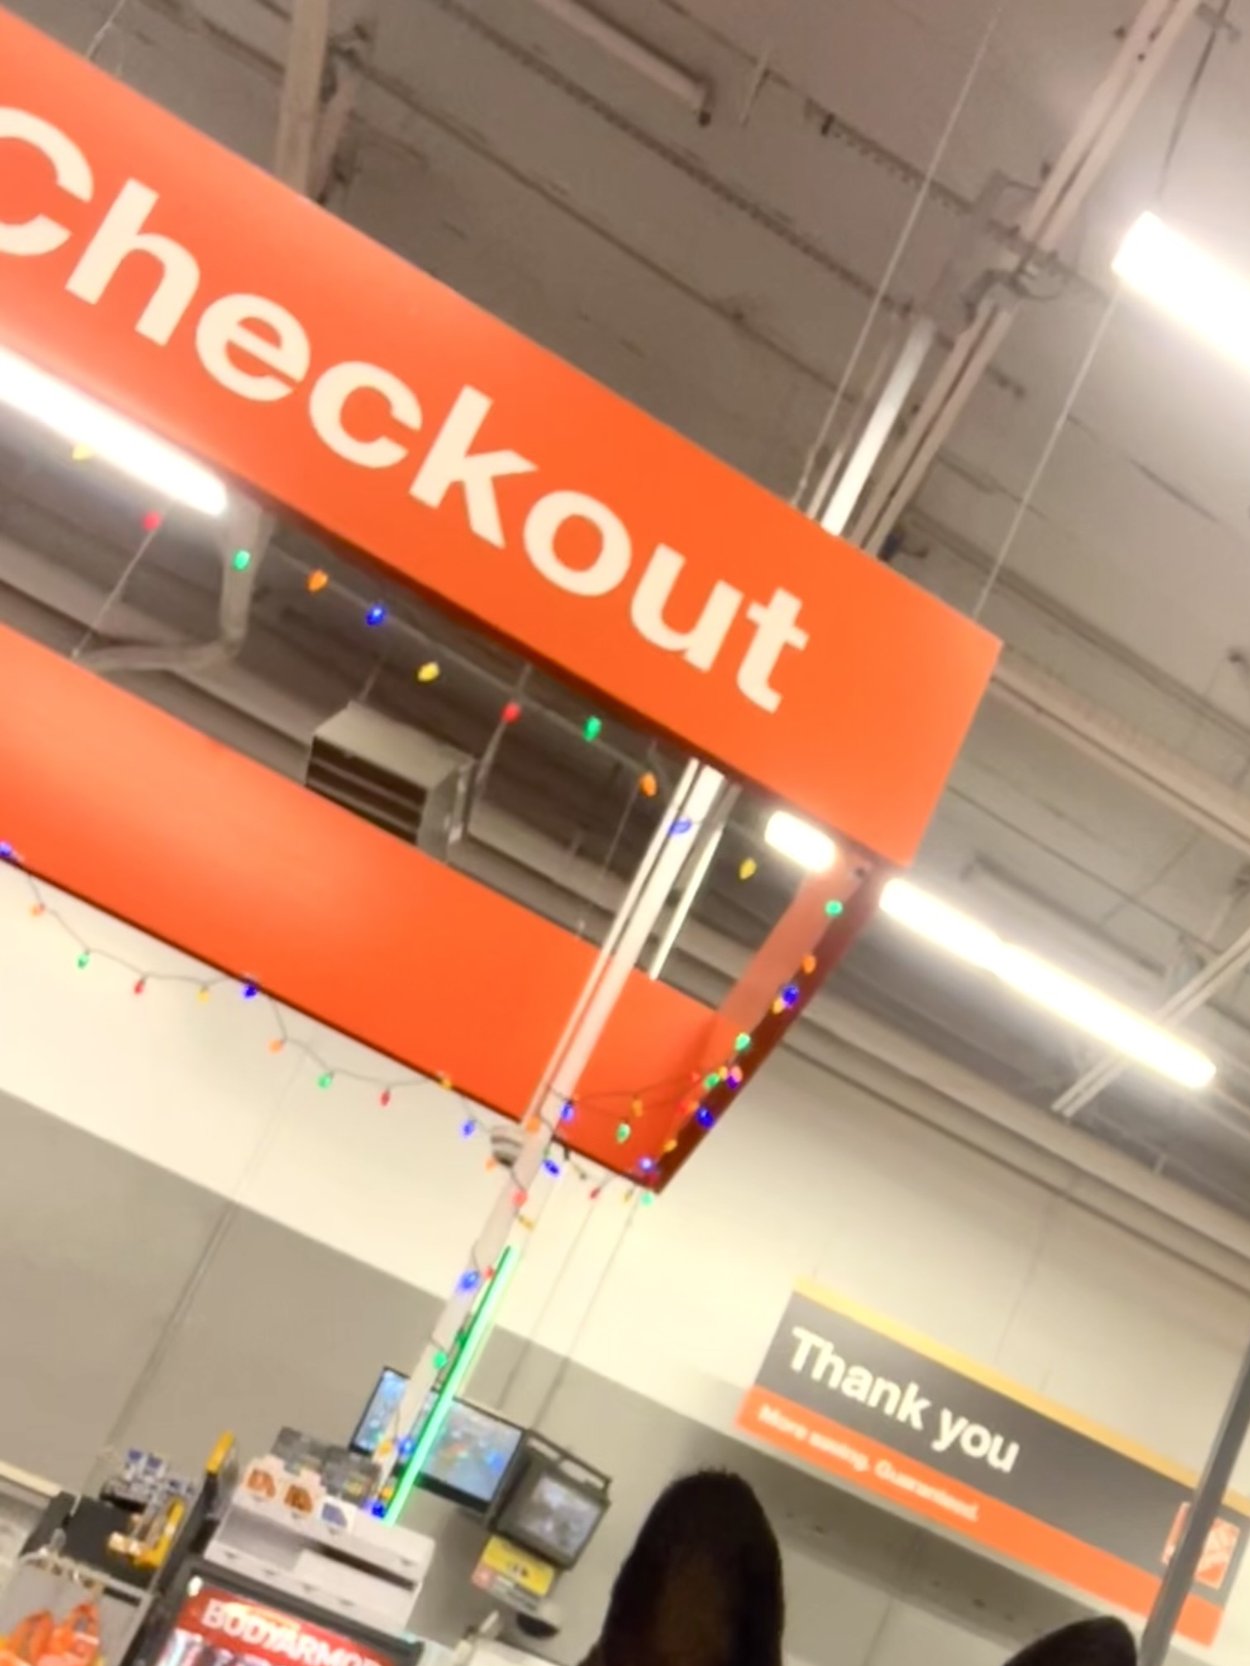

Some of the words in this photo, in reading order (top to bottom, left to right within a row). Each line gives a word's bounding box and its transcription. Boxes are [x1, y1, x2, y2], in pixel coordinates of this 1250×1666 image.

[0, 106, 809, 713] Checkout
[790, 1325, 932, 1431] Thank
[930, 1406, 1021, 1474] you
